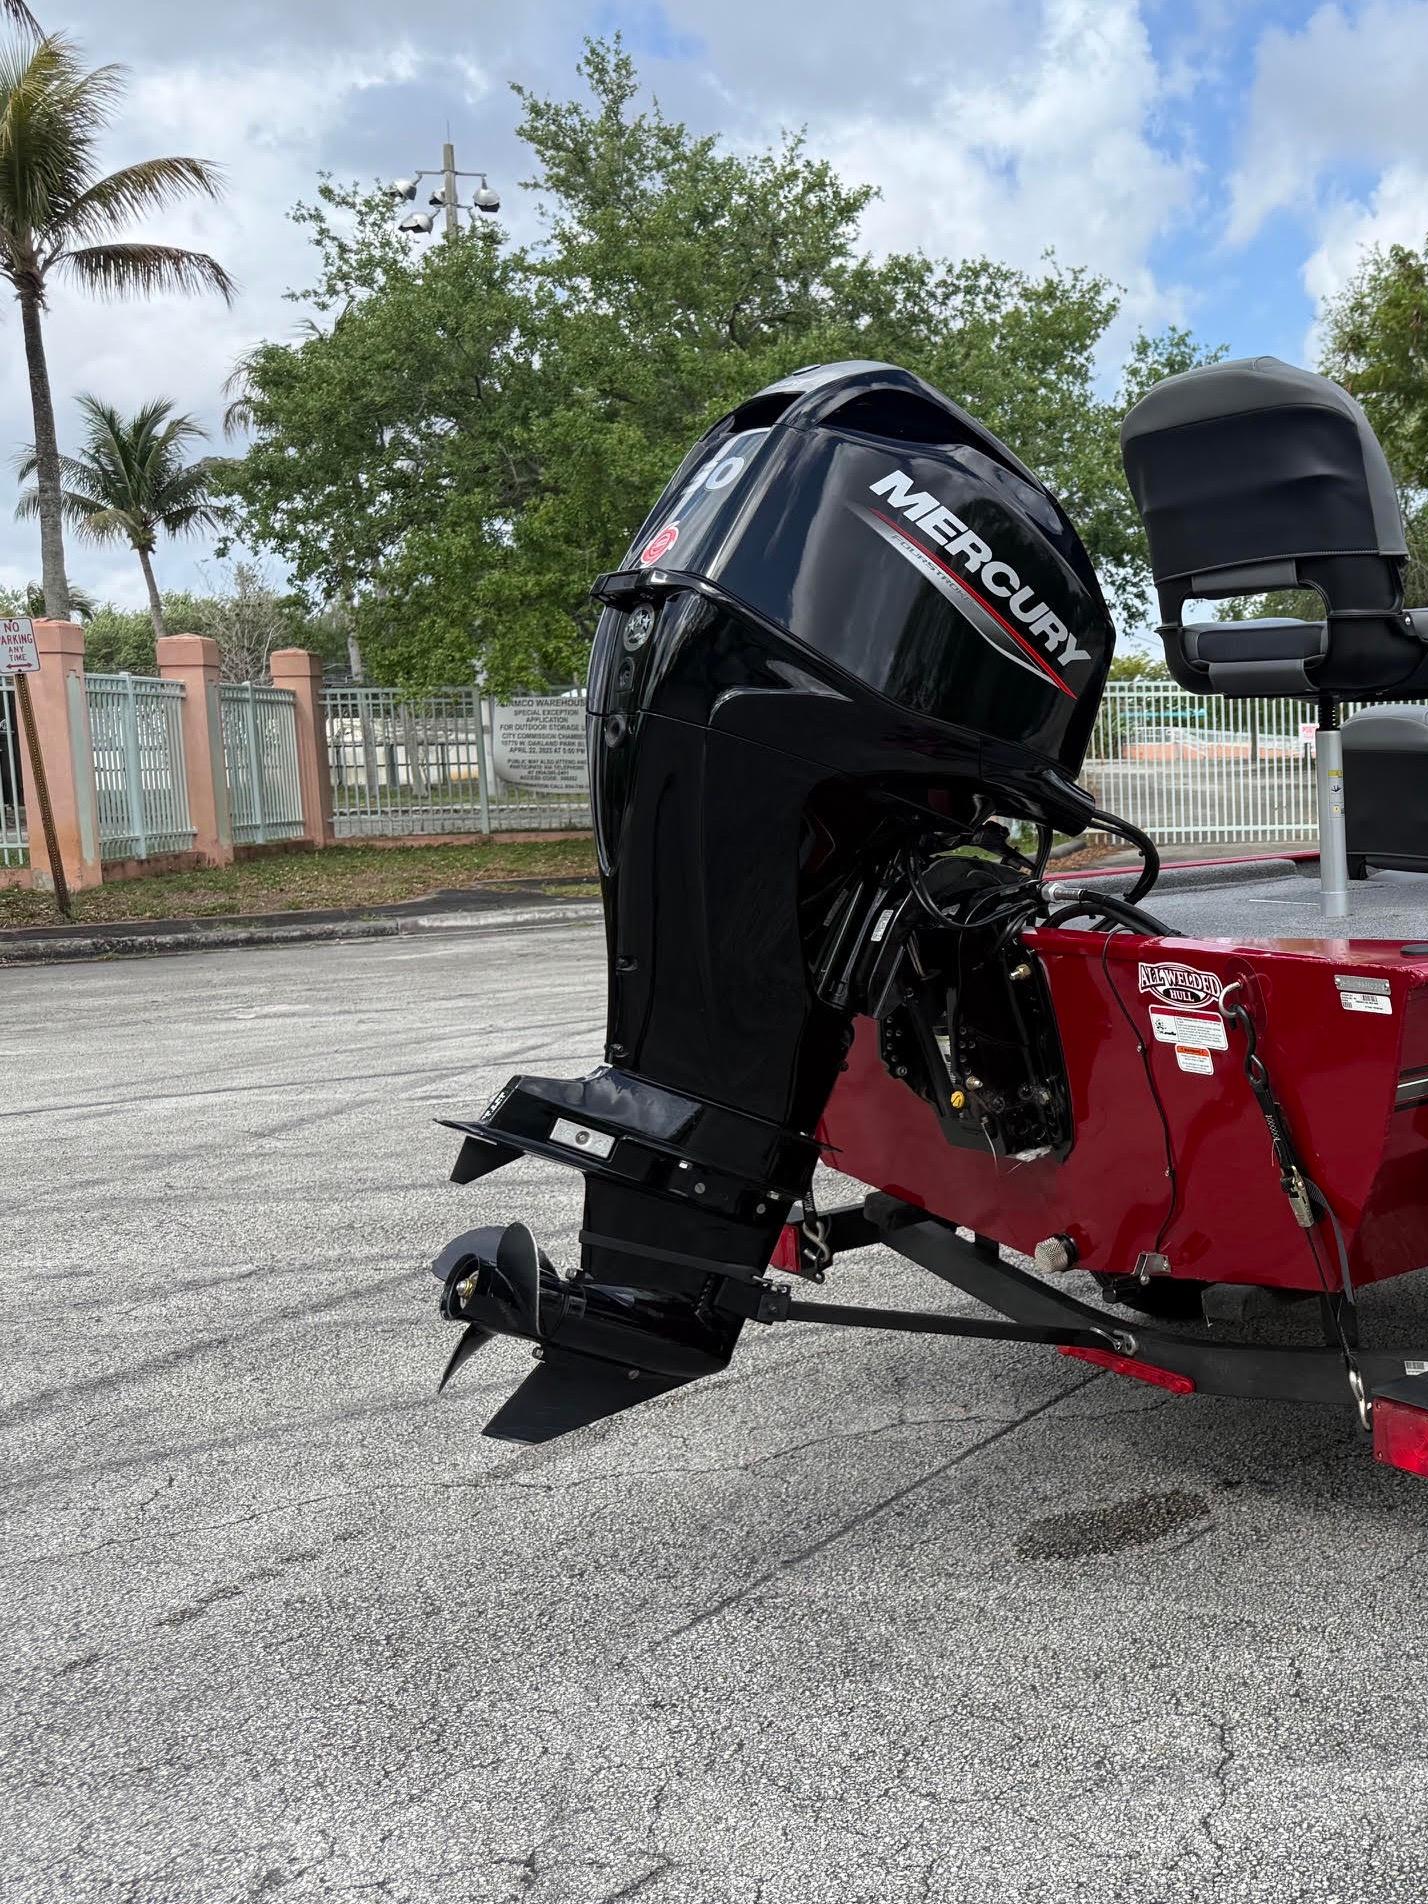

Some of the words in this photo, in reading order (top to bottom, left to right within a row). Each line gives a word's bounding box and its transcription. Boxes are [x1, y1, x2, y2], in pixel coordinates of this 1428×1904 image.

[868, 469, 1092, 667] MERCURY
[4, 621, 20, 633] NO
[0, 633, 33, 646] ARKING
[8, 646, 24, 654] ANY
[8, 653, 28, 662] TIME
[535, 699, 587, 707] WAREHOUS
[500, 723, 514, 731] FOR
[1140, 965, 1165, 989] ALL
[1163, 968, 1221, 998] WELDED
[1169, 990, 1195, 1002] HULL
